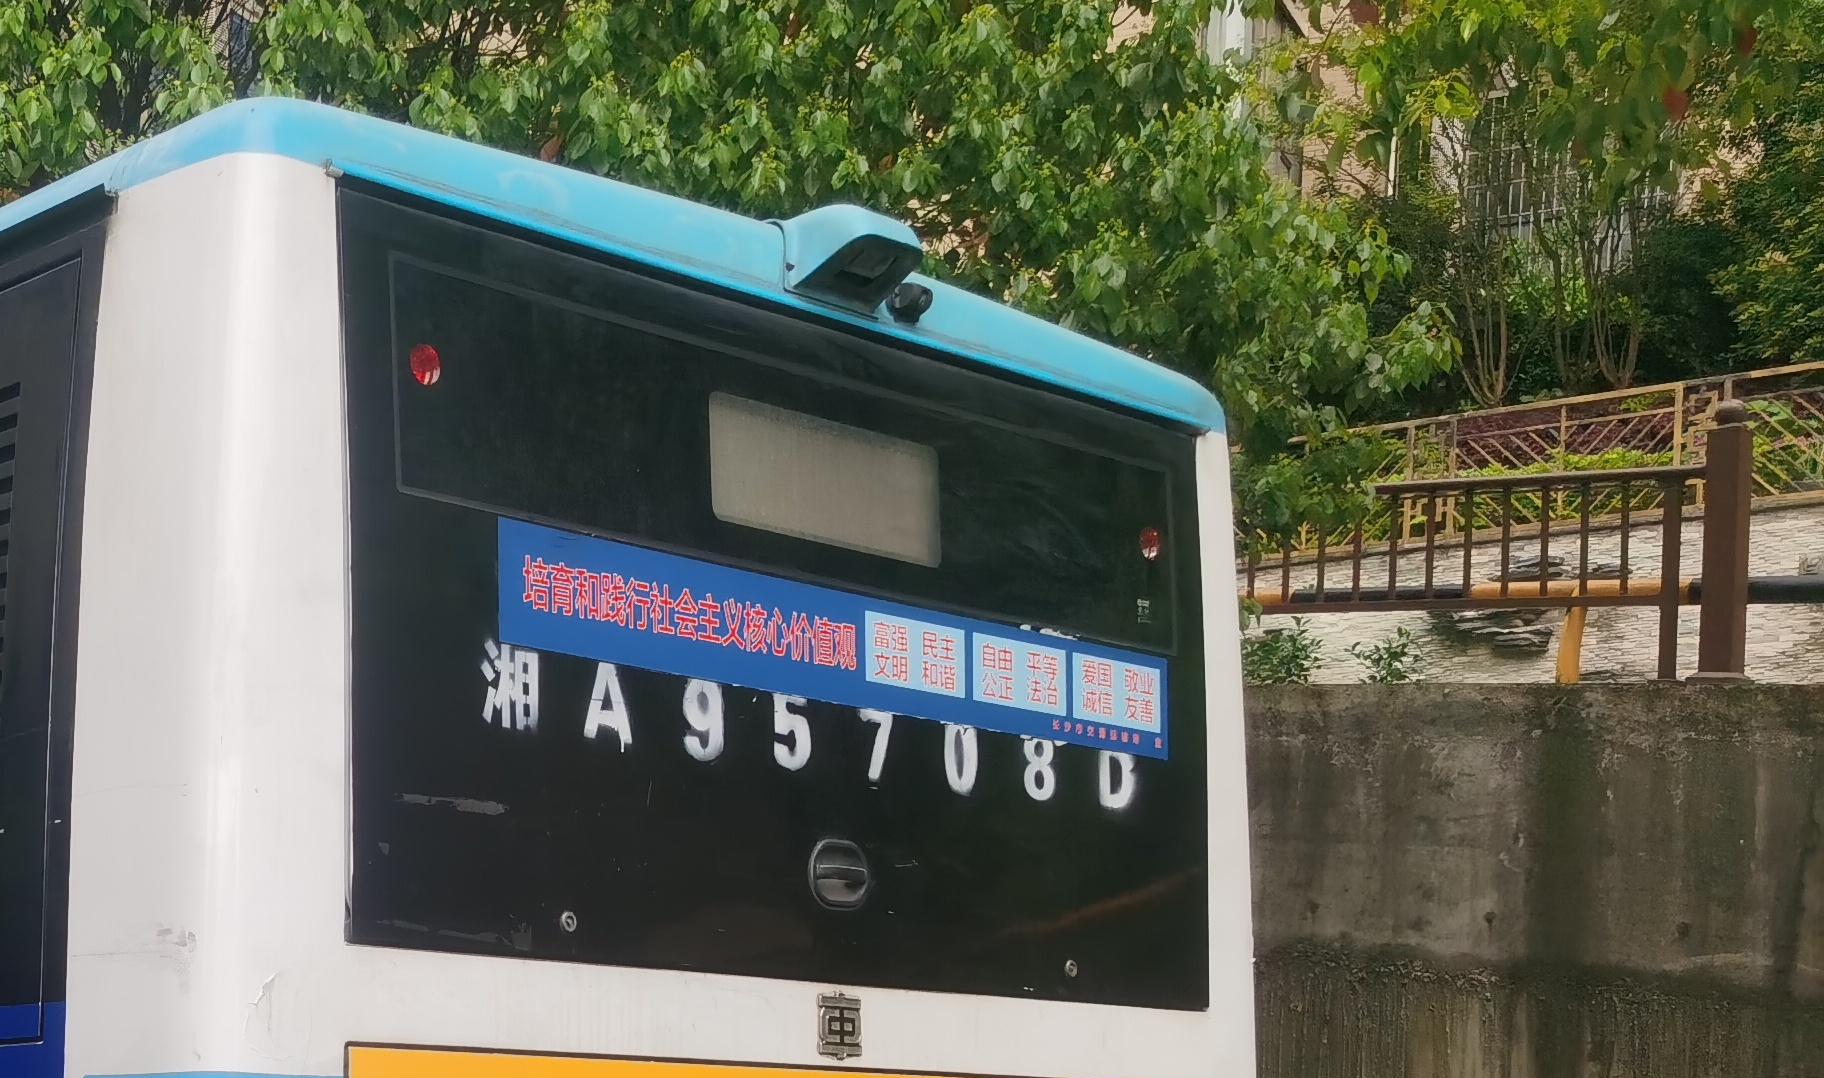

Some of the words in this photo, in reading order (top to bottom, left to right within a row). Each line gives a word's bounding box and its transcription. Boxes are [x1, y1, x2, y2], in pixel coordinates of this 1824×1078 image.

[523, 555, 857, 671] 培育和践行社会主义核心价值观
[873, 621, 909, 652] 富强
[922, 631, 956, 661] 民主
[873, 651, 908, 683] 文明
[922, 661, 956, 692] 和谐
[982, 643, 1014, 672] 自由
[1026, 651, 1059, 681] 平等
[1082, 659, 1113, 688] 爱国
[1124, 667, 1155, 696] 敬业
[982, 671, 1014, 701] 公正
[1026, 677, 1058, 707] 法治
[1082, 688, 1113, 717] 诚信
[1124, 696, 1154, 725] 友善
